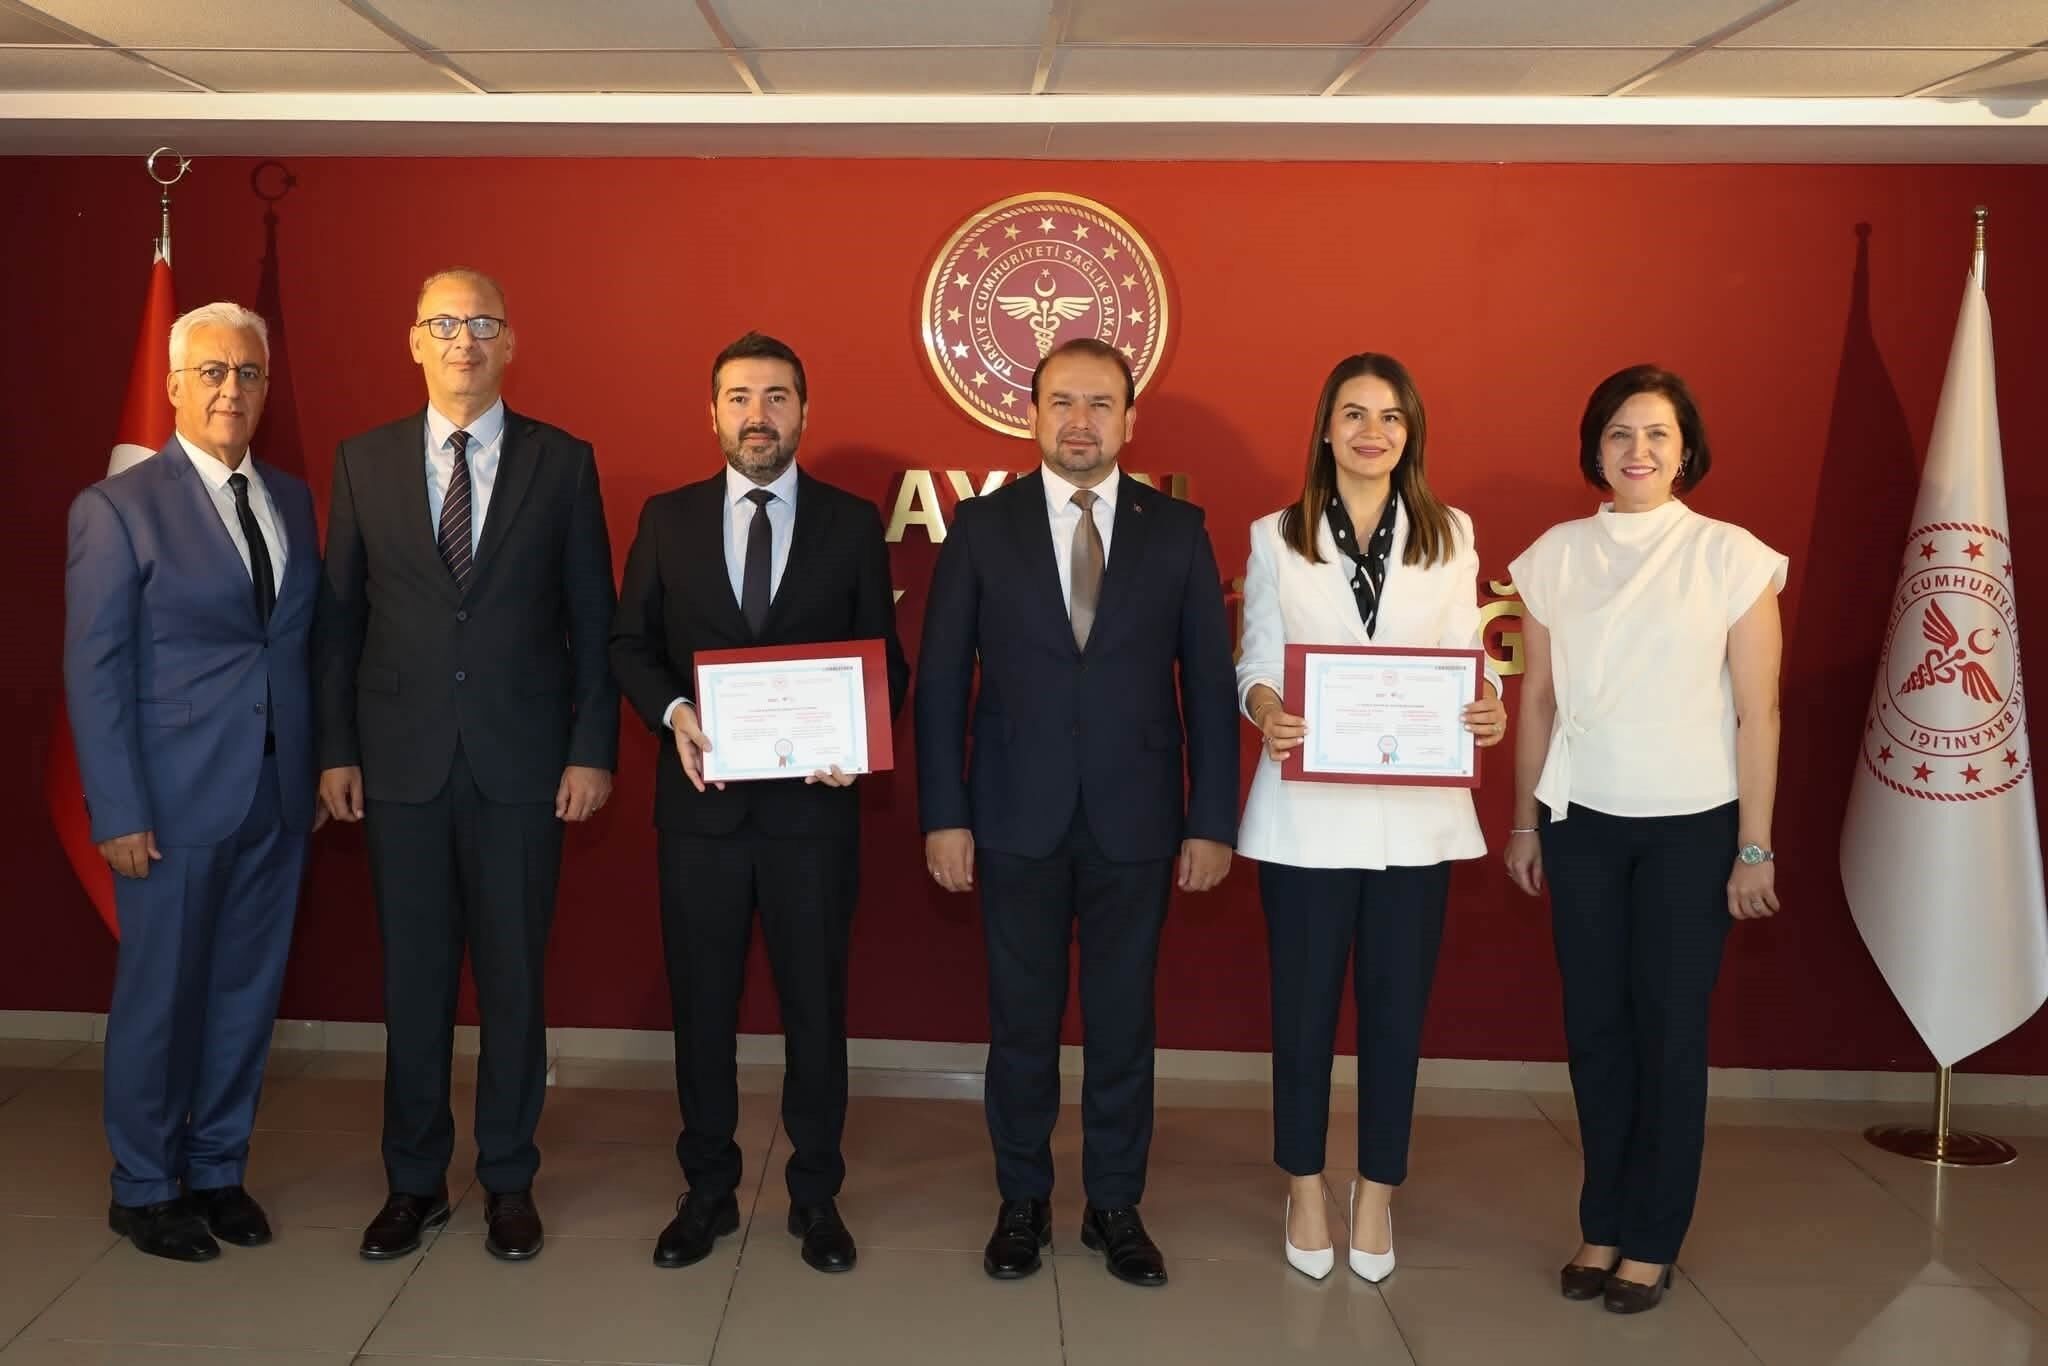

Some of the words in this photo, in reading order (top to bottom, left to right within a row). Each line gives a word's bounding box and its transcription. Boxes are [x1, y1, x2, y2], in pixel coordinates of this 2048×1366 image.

[975, 245, 1060, 310] CUMHURİYETİ
[1063, 249, 1109, 292] SAĞLIK
[975, 316, 1013, 377] TÜRKİYE
[1910, 711, 2014, 749] BAKANLIĞI
